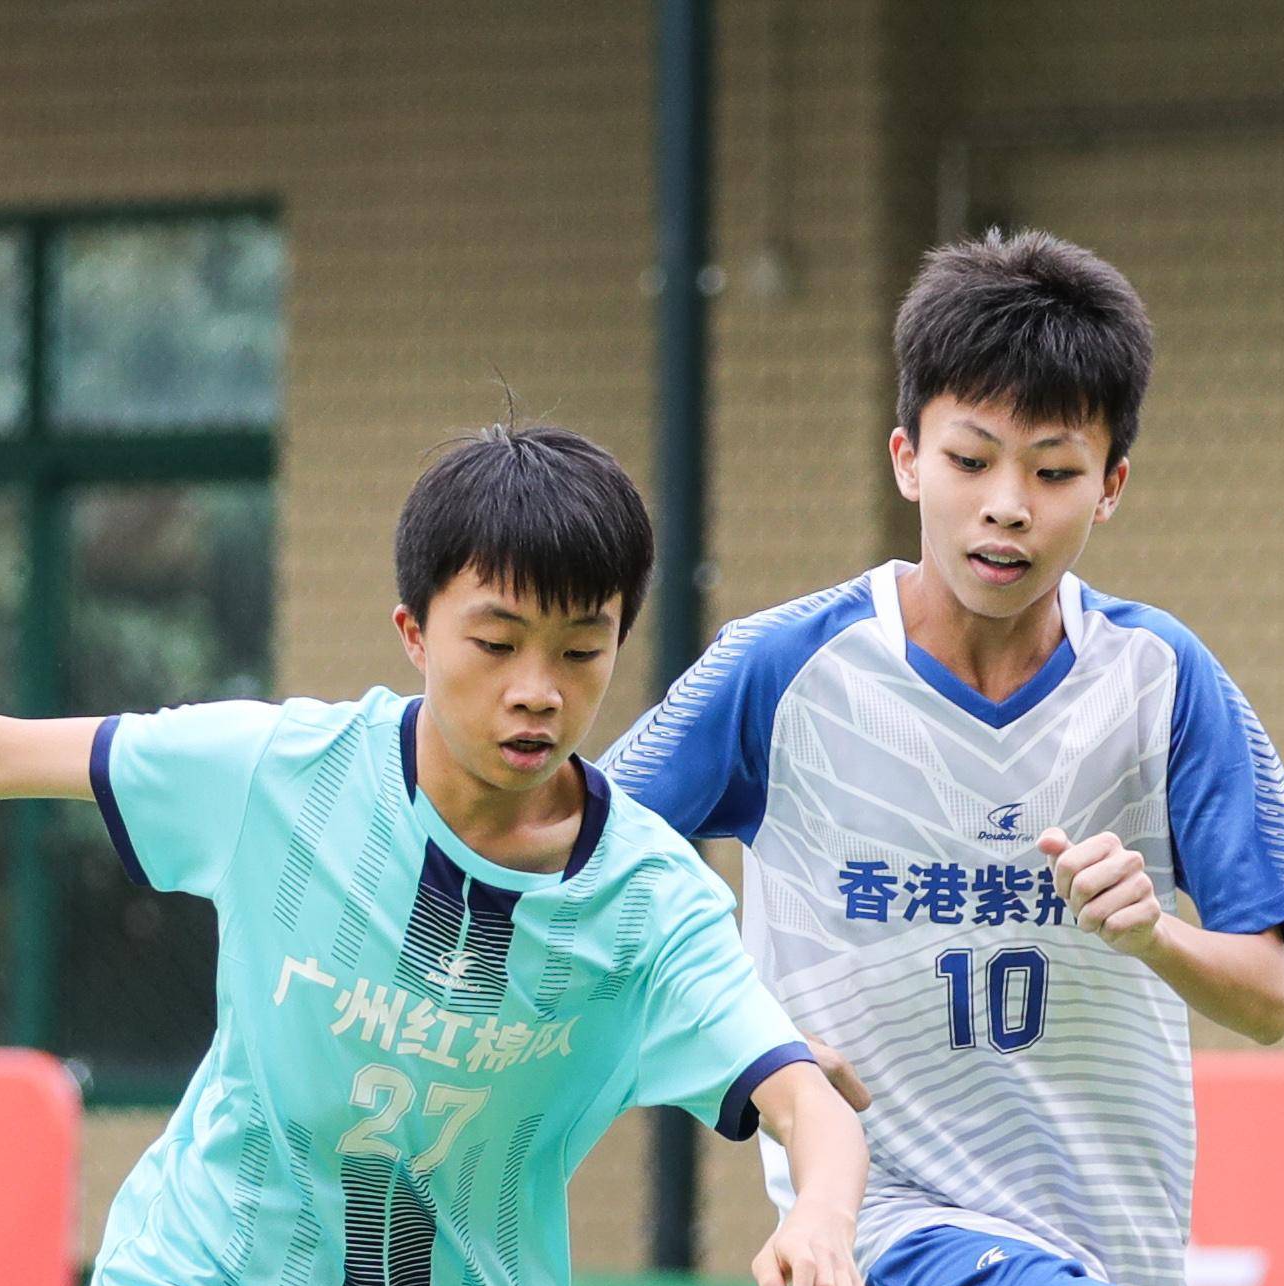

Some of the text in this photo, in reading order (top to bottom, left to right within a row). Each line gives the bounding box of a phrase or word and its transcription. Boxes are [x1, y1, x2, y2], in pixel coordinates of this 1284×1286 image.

[272, 955, 583, 1073] 广州红棉队
[935, 945, 1049, 1054] 10
[335, 1062, 492, 1174] 27
